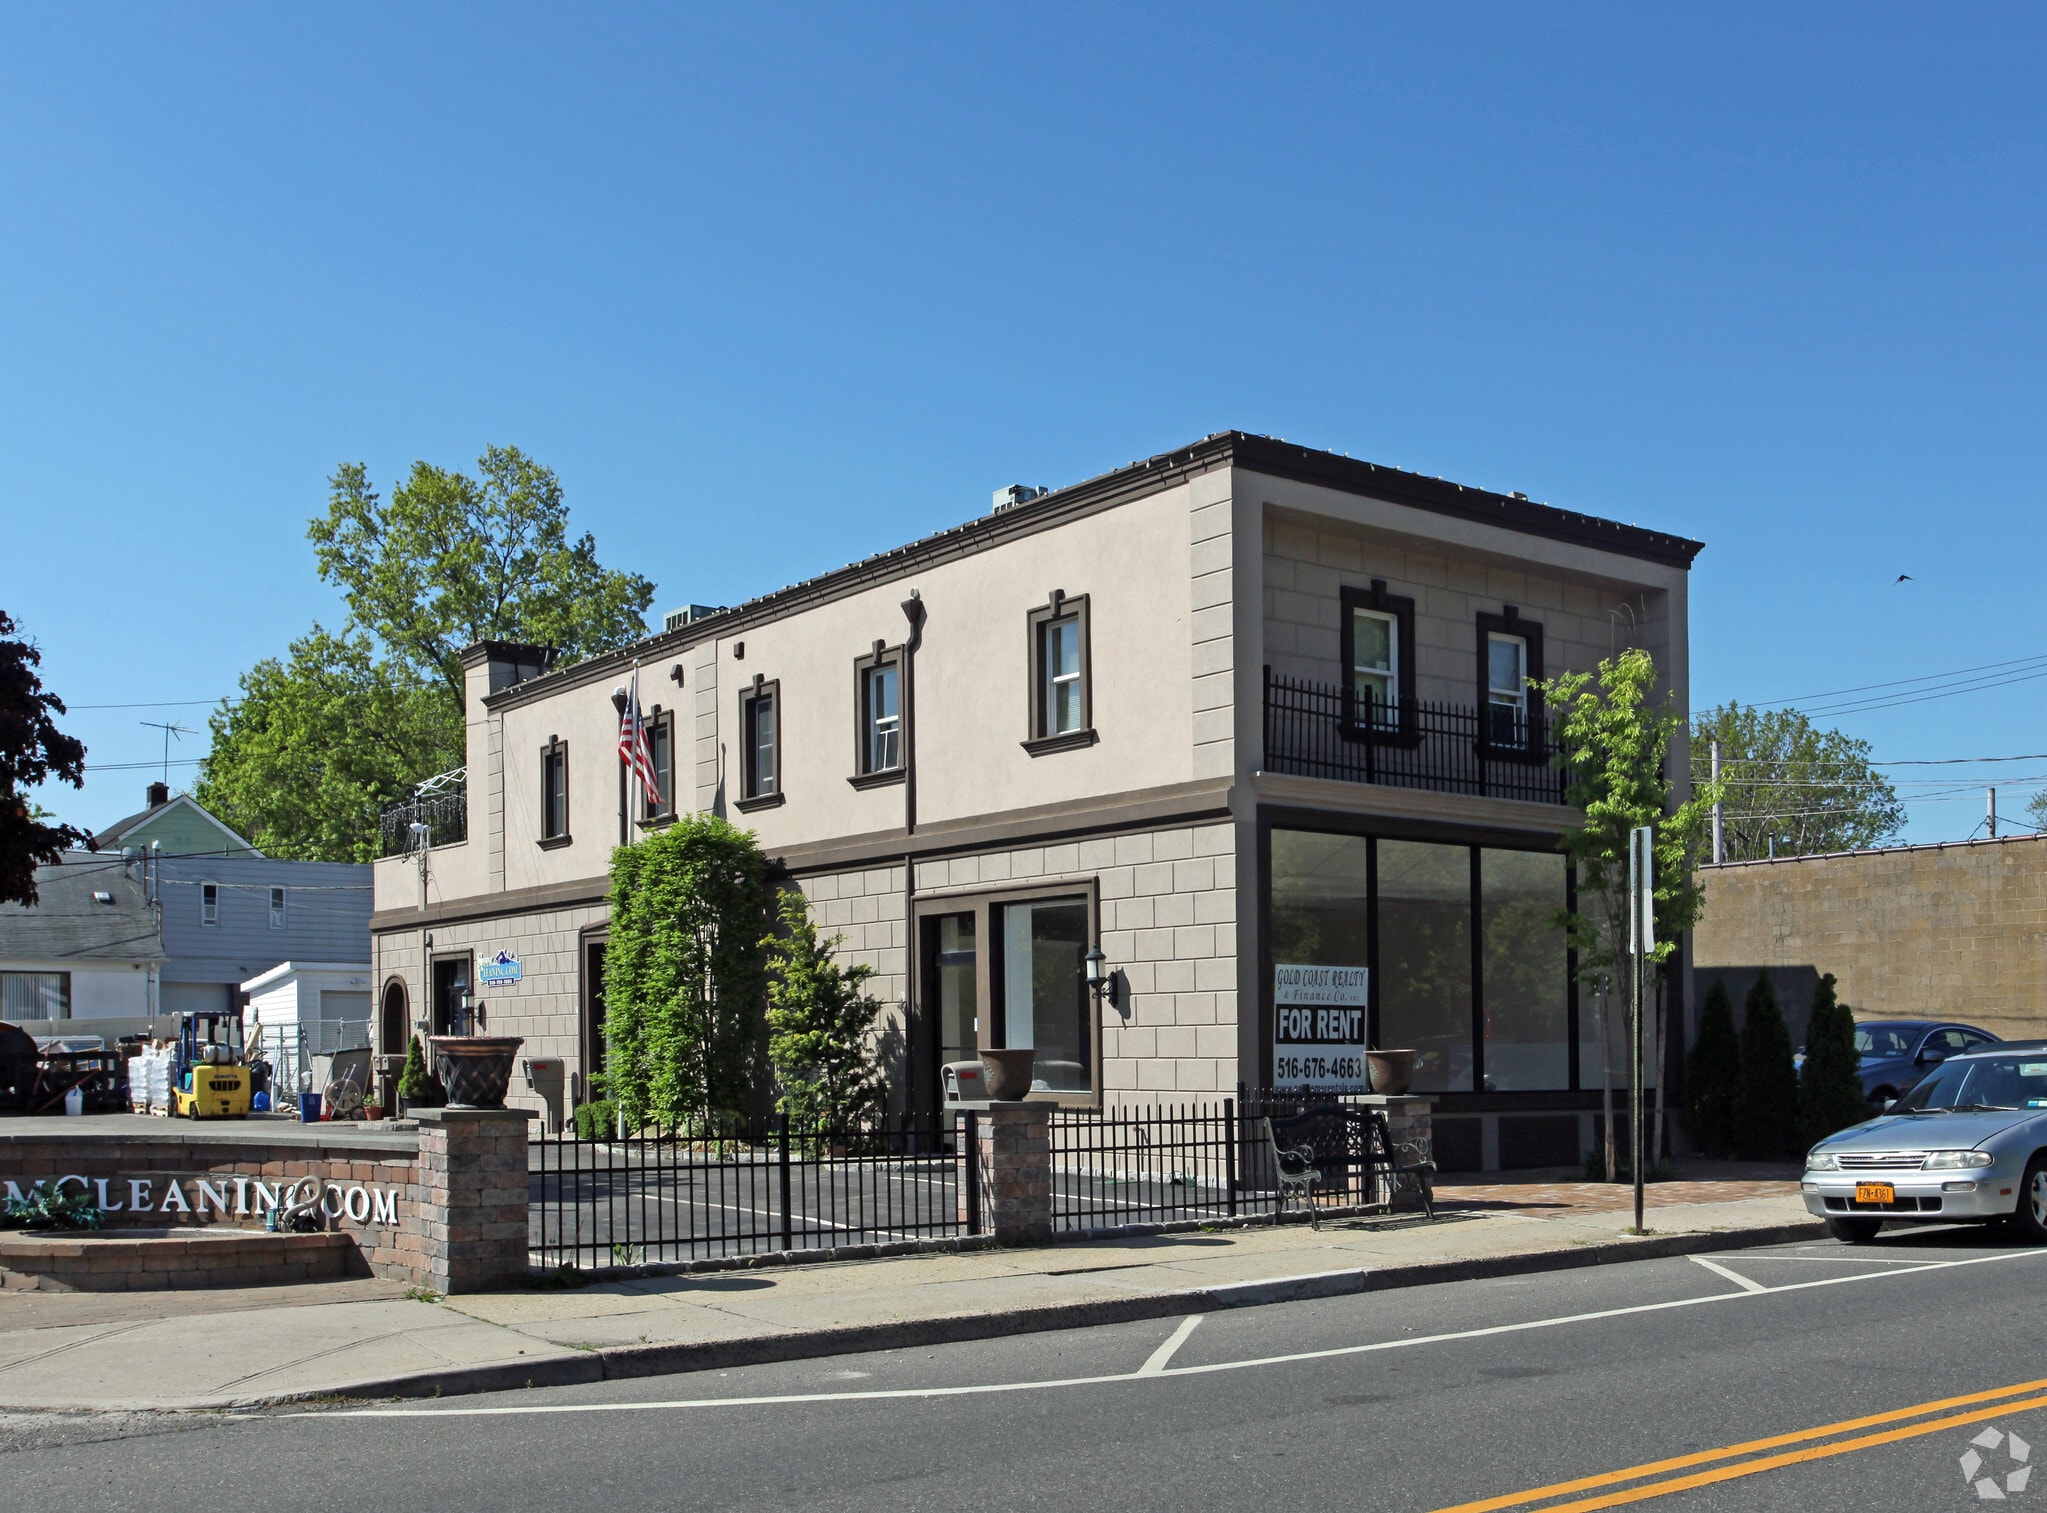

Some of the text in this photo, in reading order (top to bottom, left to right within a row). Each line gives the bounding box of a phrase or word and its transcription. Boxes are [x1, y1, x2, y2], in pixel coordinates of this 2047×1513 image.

[1277, 969, 1366, 990] GOLD COAST REALTY
[1293, 989, 1331, 1001] Finance
[1279, 1008, 1362, 1040] FOR RENT
[1277, 1057, 1362, 1079] 516-676-4663
